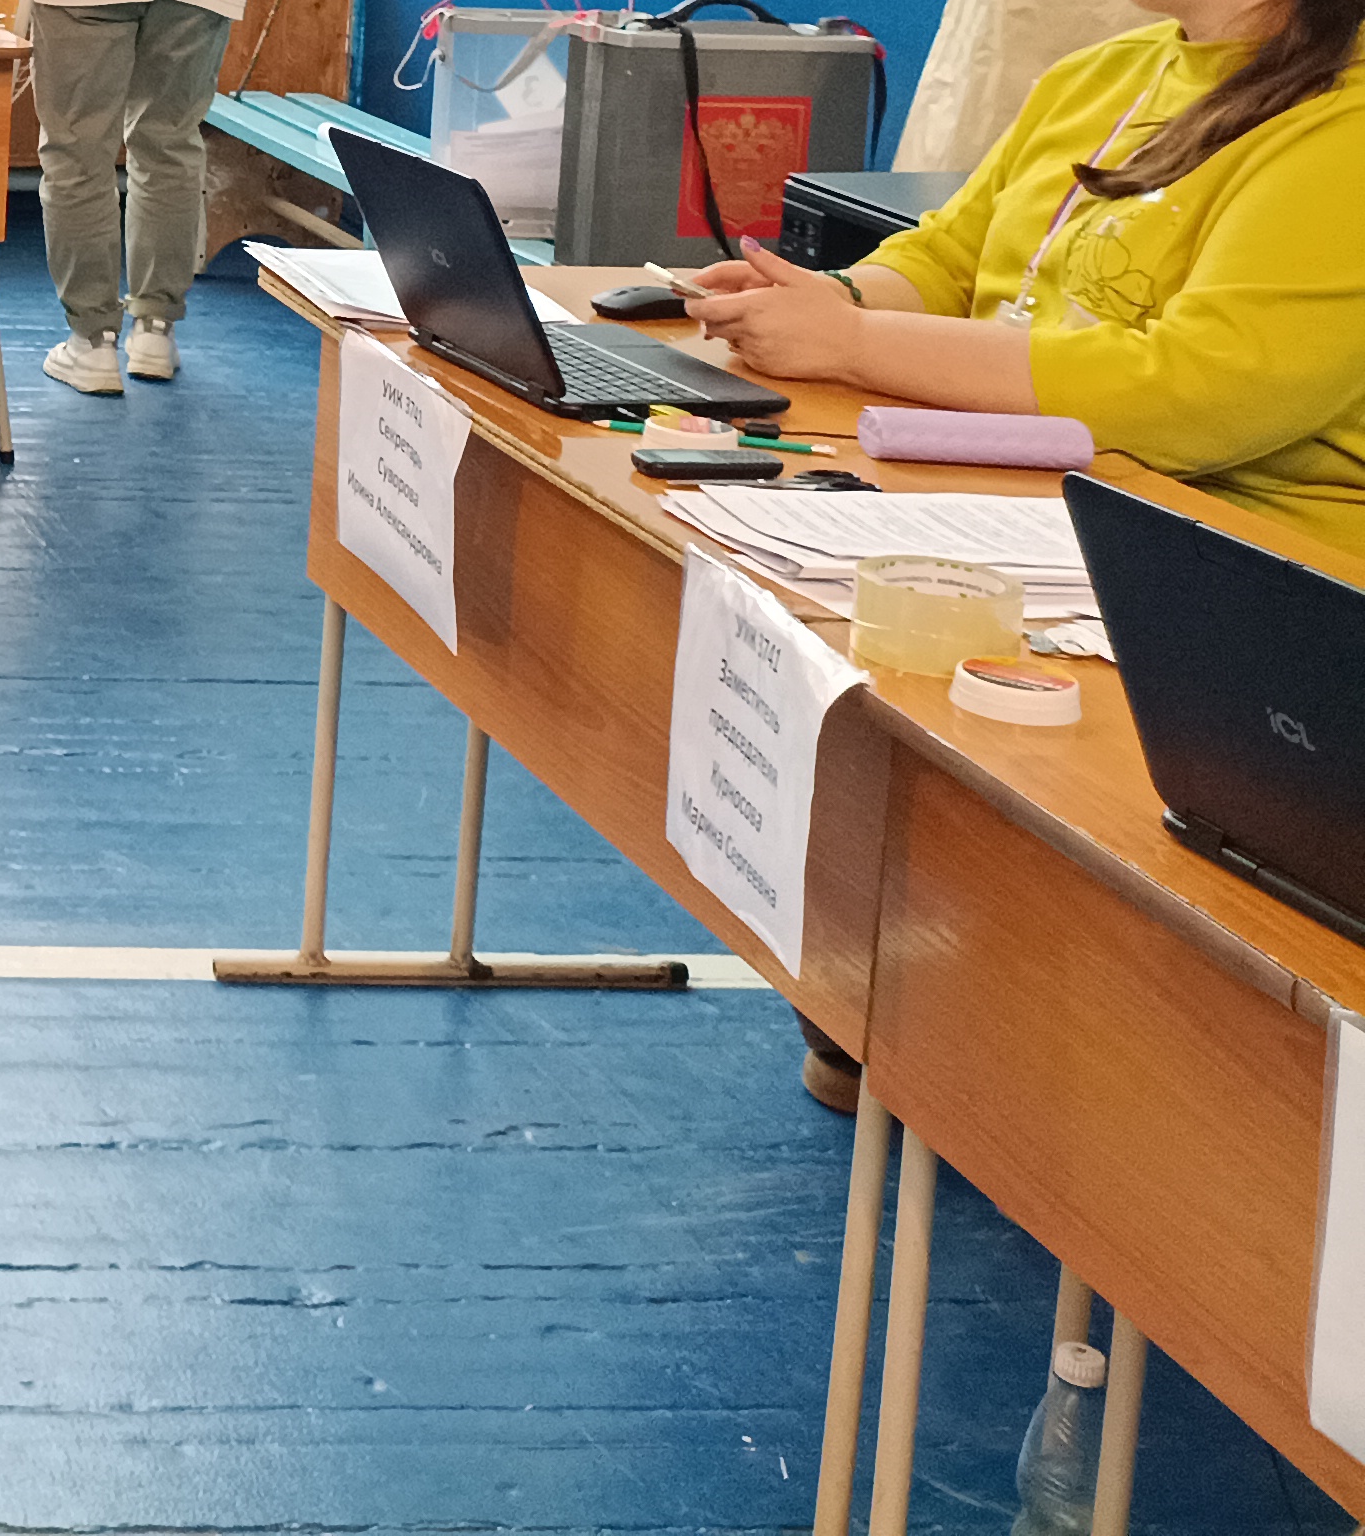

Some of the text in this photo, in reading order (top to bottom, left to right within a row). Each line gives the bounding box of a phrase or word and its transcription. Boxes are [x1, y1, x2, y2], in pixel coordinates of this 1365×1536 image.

[382, 379, 403, 410] УИК
[378, 416, 423, 470] Секретарь
[377, 456, 419, 508] Суворова
[348, 468, 443, 576] Ирина Александровна
[757, 632, 781, 673] 3741
[718, 658, 781, 735] Заместитель
[708, 708, 778, 787] председателя
[710, 760, 763, 833] Курносова
[681, 789, 777, 909] Марина Сергеевна
